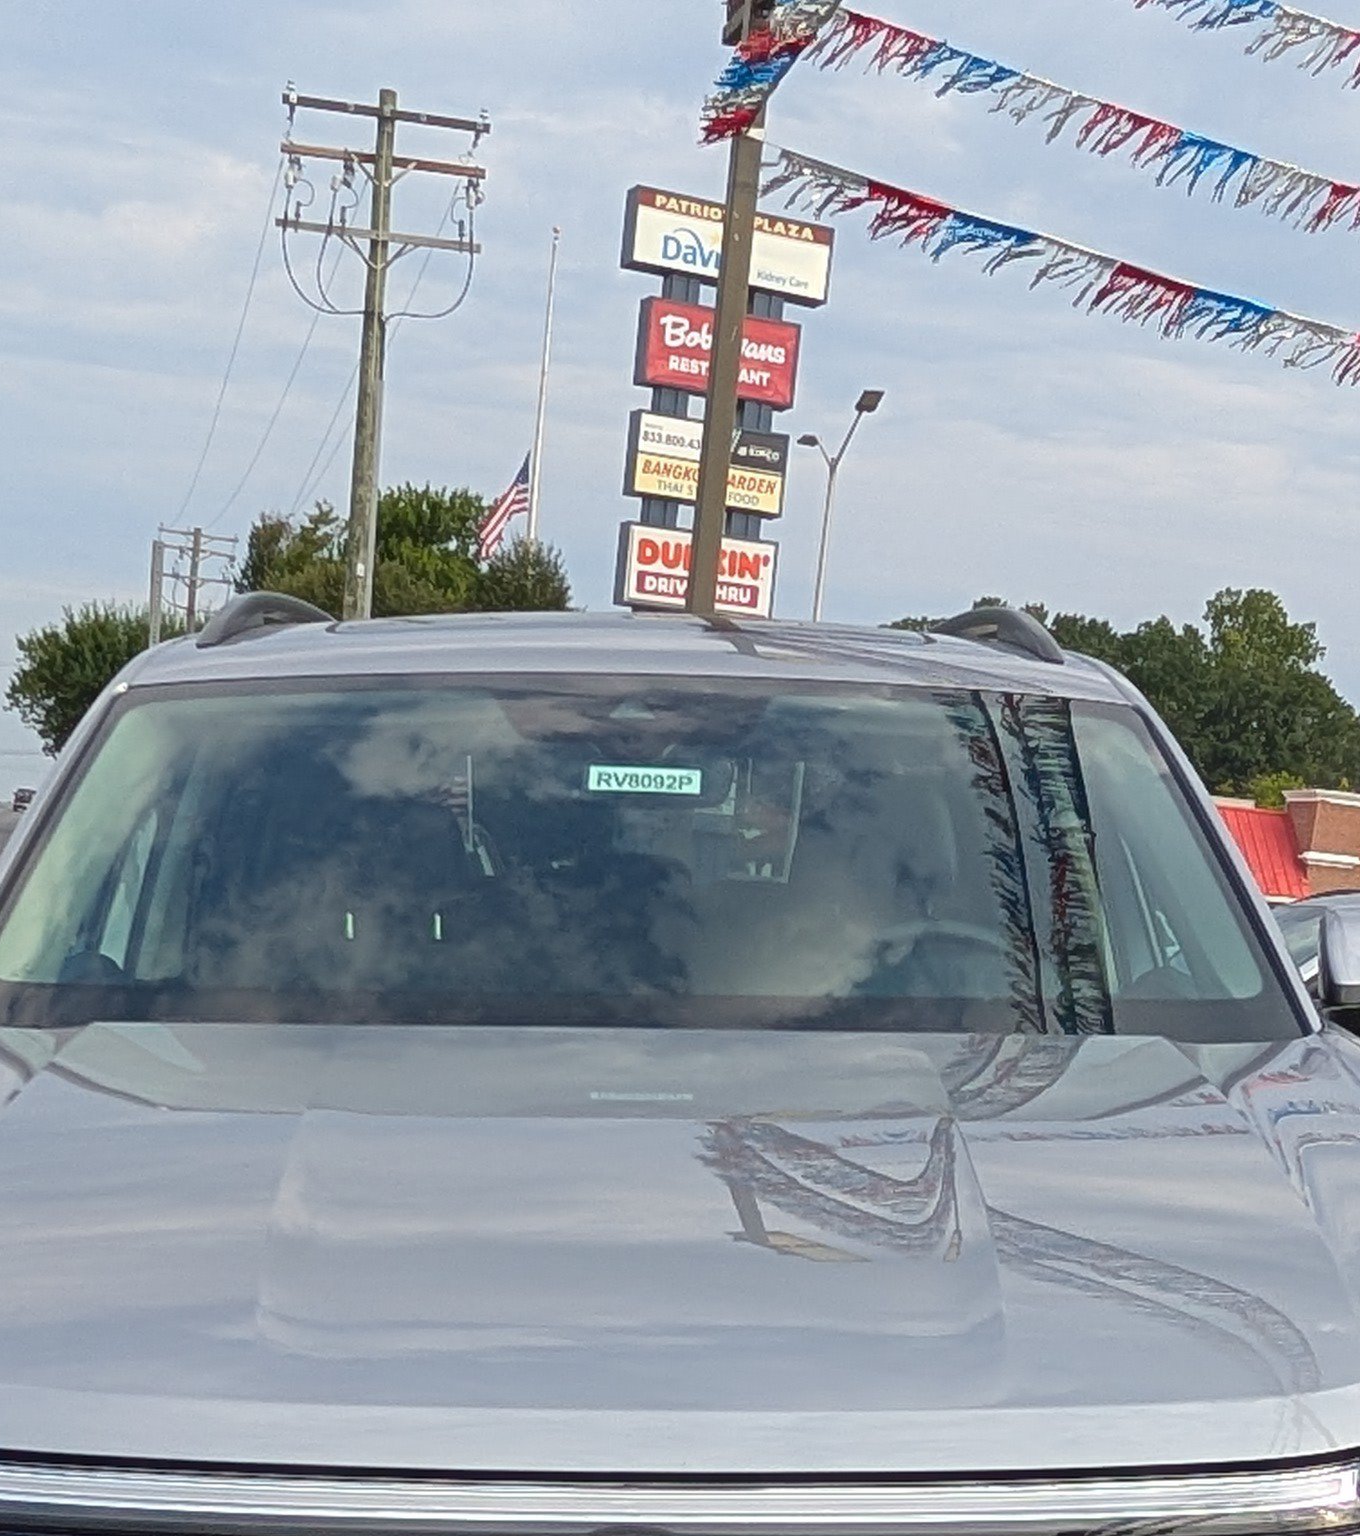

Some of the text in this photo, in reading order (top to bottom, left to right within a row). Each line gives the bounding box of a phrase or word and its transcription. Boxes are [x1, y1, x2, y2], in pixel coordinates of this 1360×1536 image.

[655, 194, 814, 242] PATRIO PLAZA
[660, 314, 713, 351] Bob
[726, 473, 777, 495] ARDEN
[644, 575, 751, 604] DRIV HRU
[595, 770, 694, 793] RV8092P
